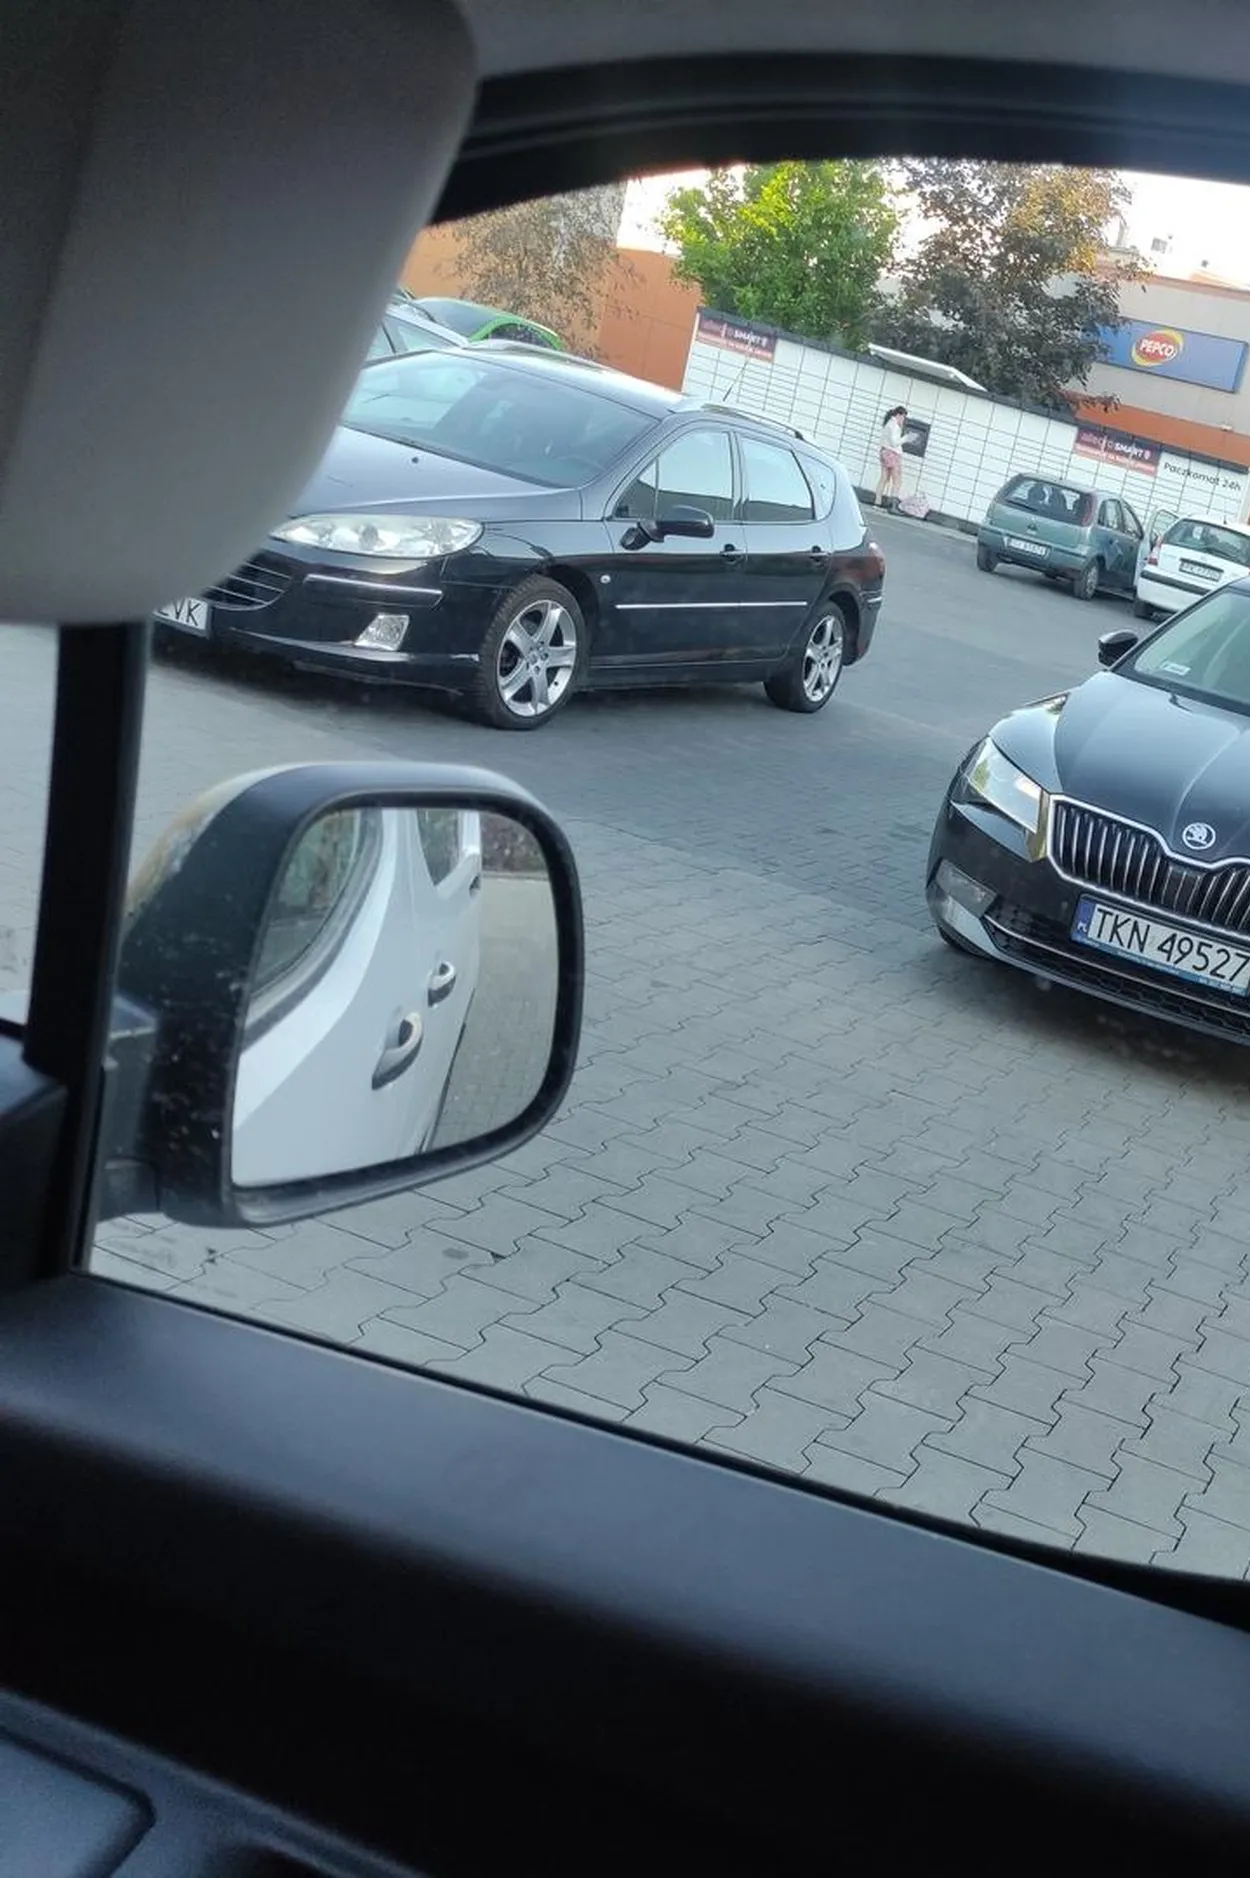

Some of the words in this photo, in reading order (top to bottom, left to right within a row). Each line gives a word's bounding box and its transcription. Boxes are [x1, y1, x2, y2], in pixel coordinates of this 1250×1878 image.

[1139, 338, 1174, 357] PEPCO
[1163, 462, 1220, 486] Paczkomat
[159, 597, 201, 627] VK
[1097, 908, 1151, 953] TKN
[1157, 932, 1250, 982] 49527
